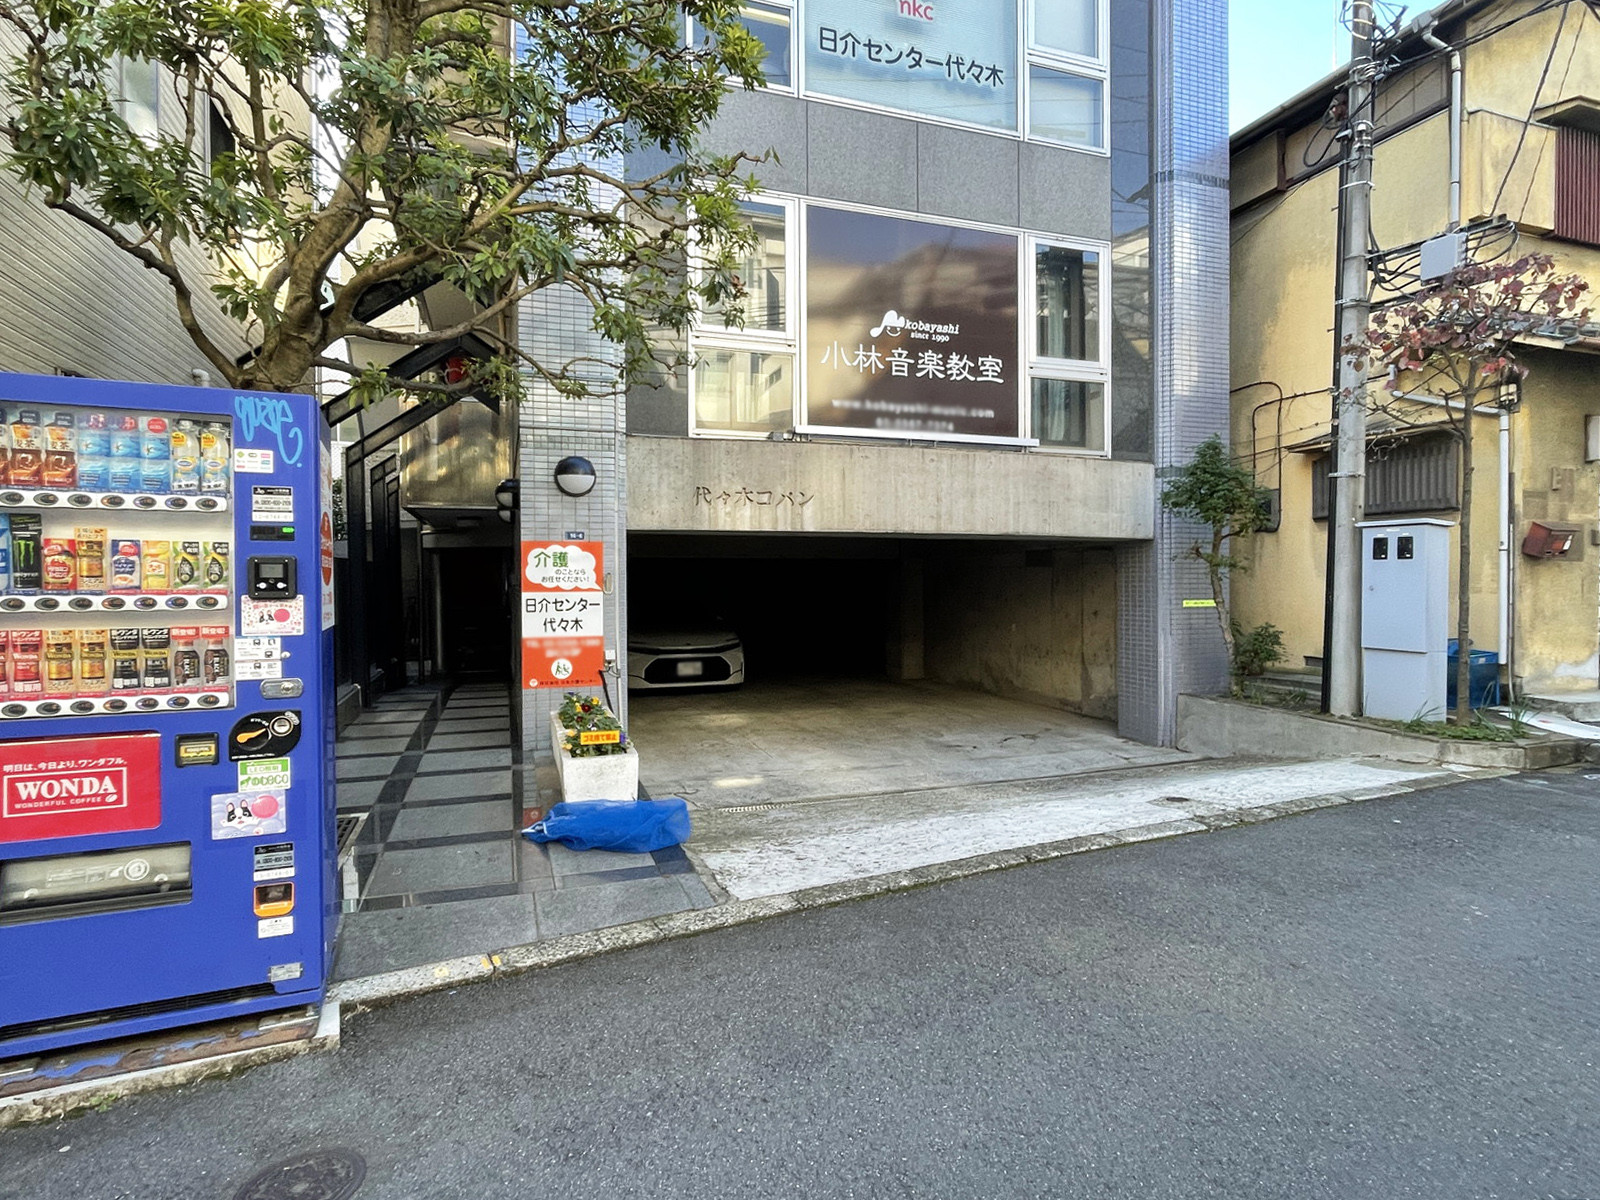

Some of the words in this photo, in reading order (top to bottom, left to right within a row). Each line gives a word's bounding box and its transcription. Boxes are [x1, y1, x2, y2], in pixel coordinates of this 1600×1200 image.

[900, 0, 934, 20] nkc
[819, 26, 1004, 87] 日介センター代々木
[905, 319, 959, 334] kobayashi
[910, 332, 929, 340] since
[931, 334, 950, 342] 1990
[820, 340, 1004, 383] 小林音楽教室
[533, 551, 568, 568] 介護
[525, 597, 600, 613] 日介センター
[543, 617, 583, 632] 代々木
[3, 757, 127, 773] 明日は、今日より、ワンダフル。
[15, 776, 117, 800] WONDA
[15, 800, 66, 809] WONDERFUL
[70, 796, 102, 805] COFFEE
